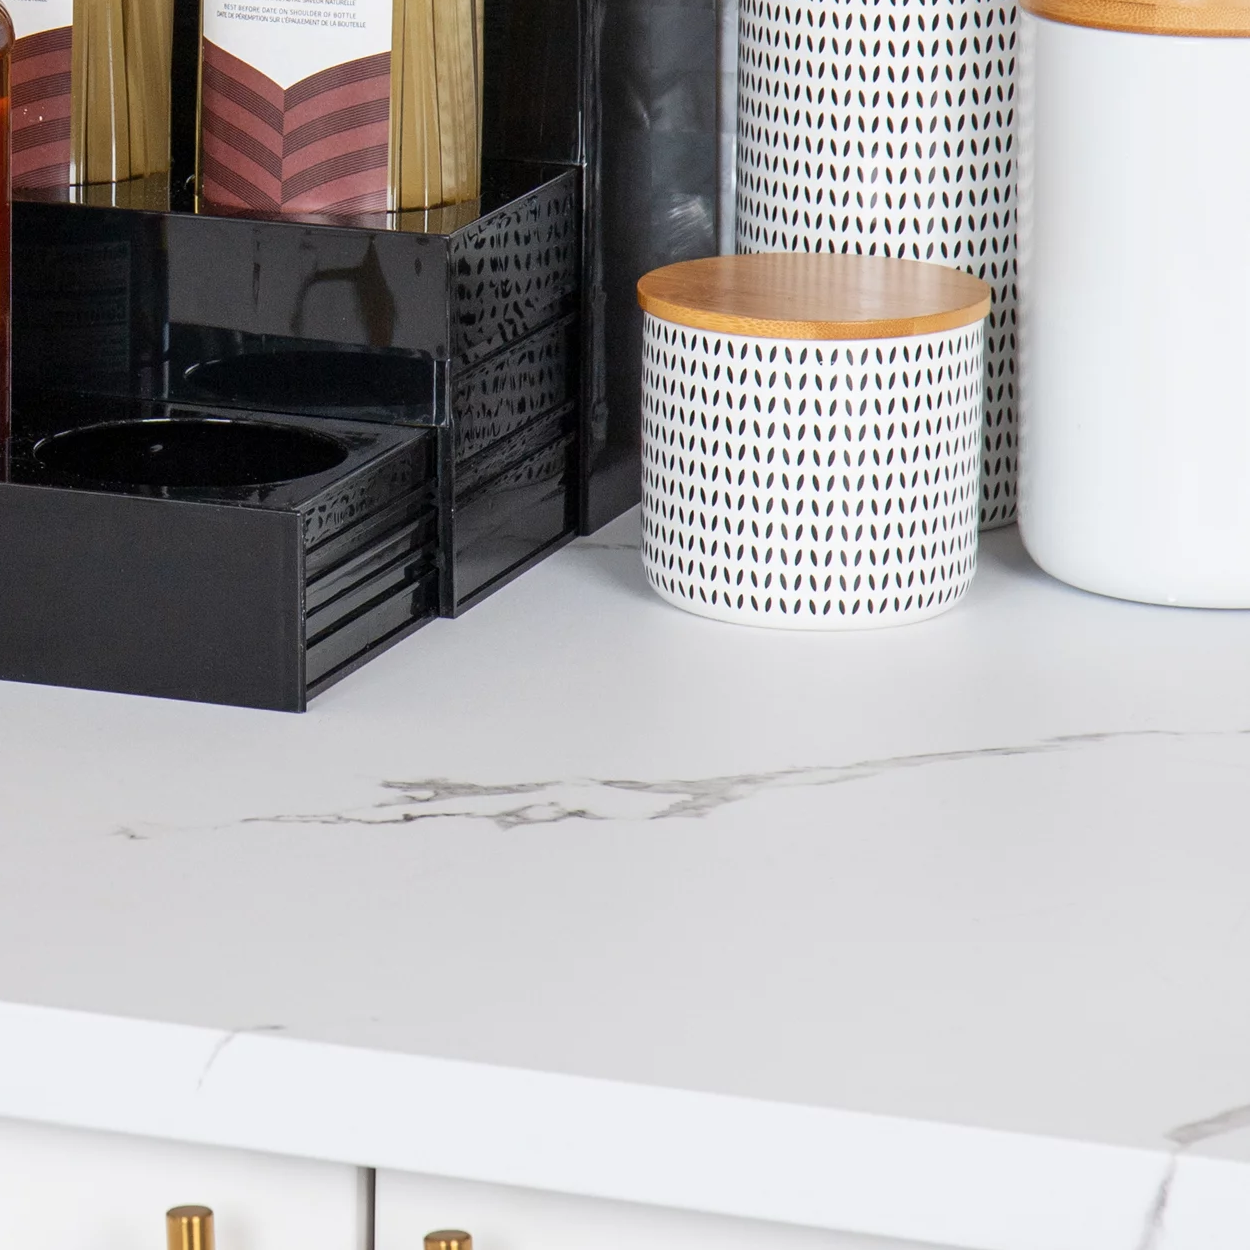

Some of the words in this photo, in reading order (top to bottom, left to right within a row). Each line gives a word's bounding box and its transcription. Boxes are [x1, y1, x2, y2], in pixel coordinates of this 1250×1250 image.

[223, 3, 237, 11] BEST
[238, 5, 261, 13] BEFORE
[290, 9, 322, 18] SHOULDER
[216, 10, 228, 18] DATE
[337, 20, 367, 28] BOUTEILLE
